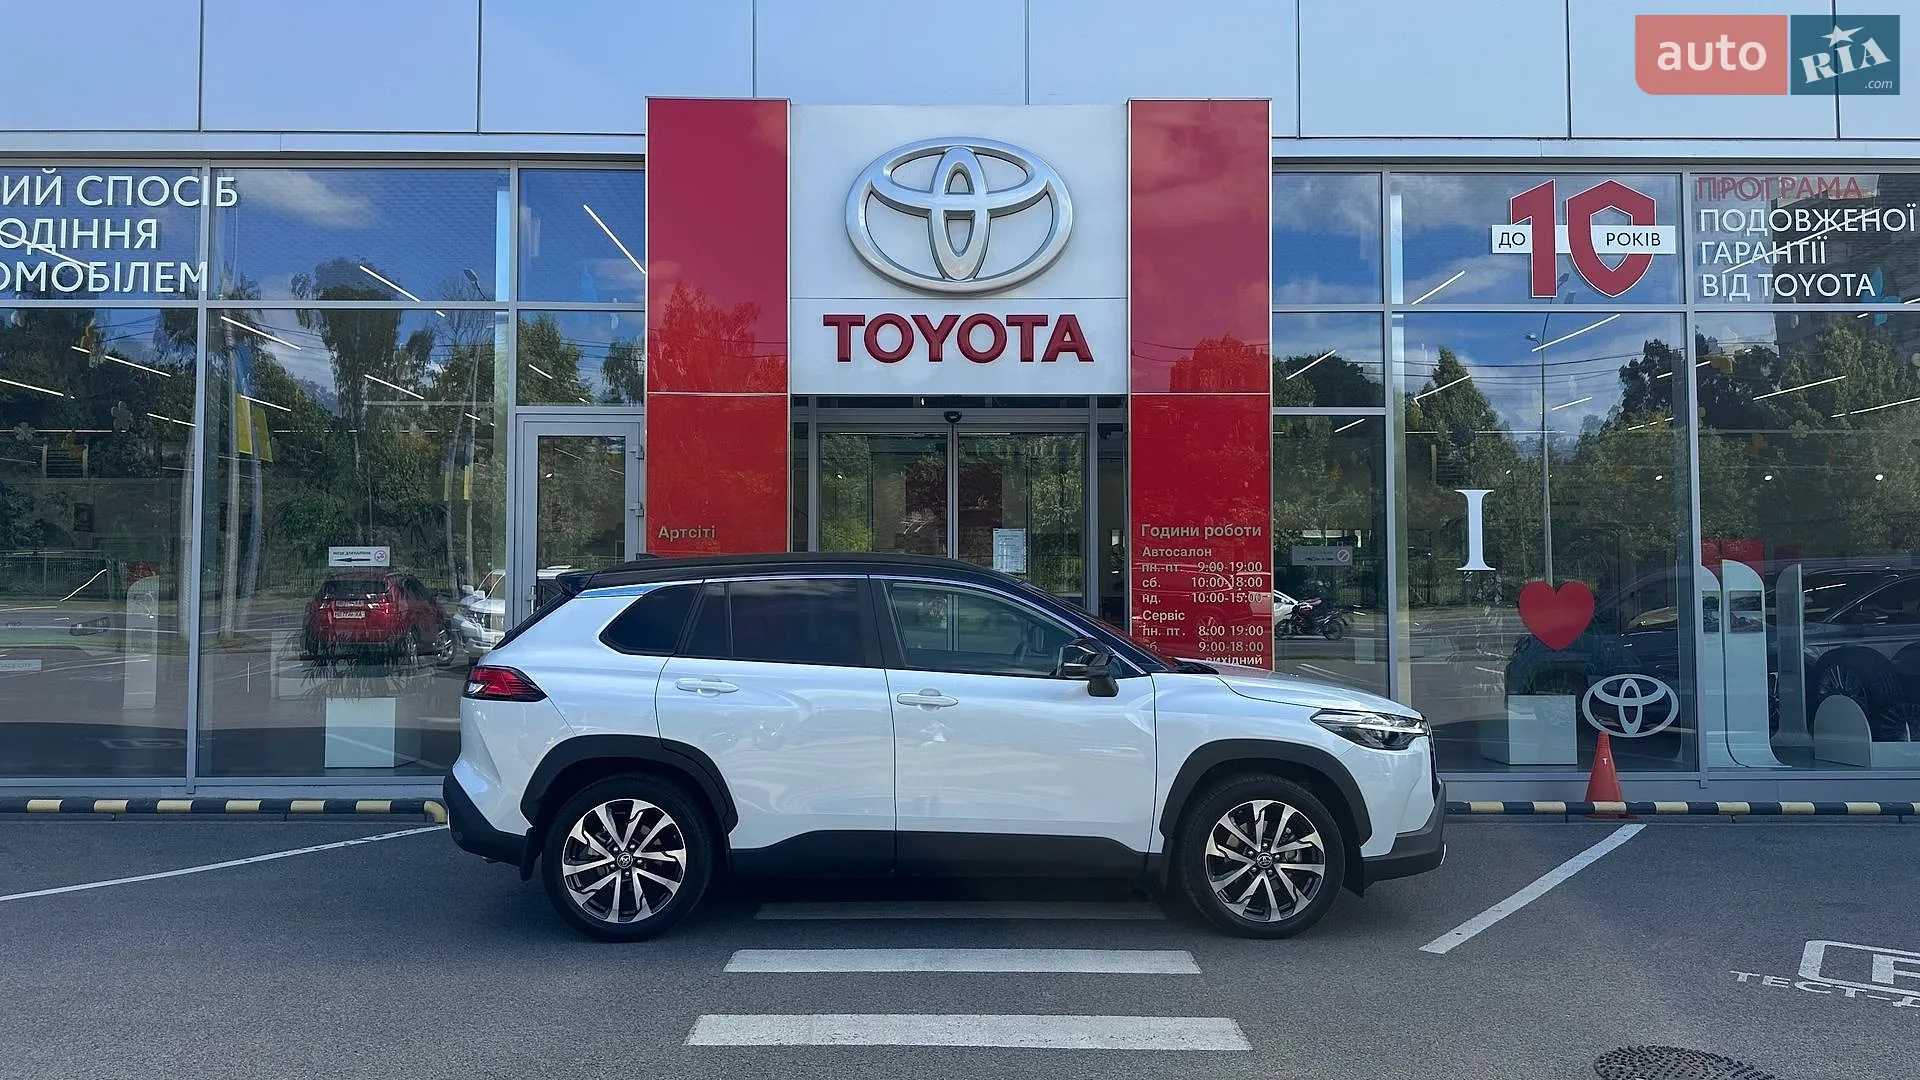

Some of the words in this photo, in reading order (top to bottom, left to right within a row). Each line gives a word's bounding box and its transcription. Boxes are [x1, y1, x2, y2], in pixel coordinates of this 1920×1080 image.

[76, 175, 239, 207] СПОСІБ
[1697, 176, 1865, 200] ПРОГРАМА
[1700, 203, 1917, 236] ПОДОВЖЕНОЇ
[1498, 233, 1526, 248] ДО
[1606, 232, 1661, 247] РОКІВ
[1701, 235, 1828, 265] ГАРАНТІЇ
[1702, 274, 1751, 302] ВІД
[1758, 274, 1876, 297] TOYOTA
[823, 314, 1094, 363] TOYOTA
[658, 525, 716, 542] Артсіті
[1141, 524, 1199, 539] Години
[1204, 524, 1261, 539] роботи
[1142, 547, 1212, 557] Автосалон
[1197, 562, 1263, 572] 9:00-19:00
[1142, 577, 1160, 588] сб.
[1191, 577, 1263, 588] 10:00-18:00
[1142, 594, 1161, 604] нд.
[1191, 592, 1263, 603] 10:00-15:00
[1142, 609, 1186, 623] Сервіс
